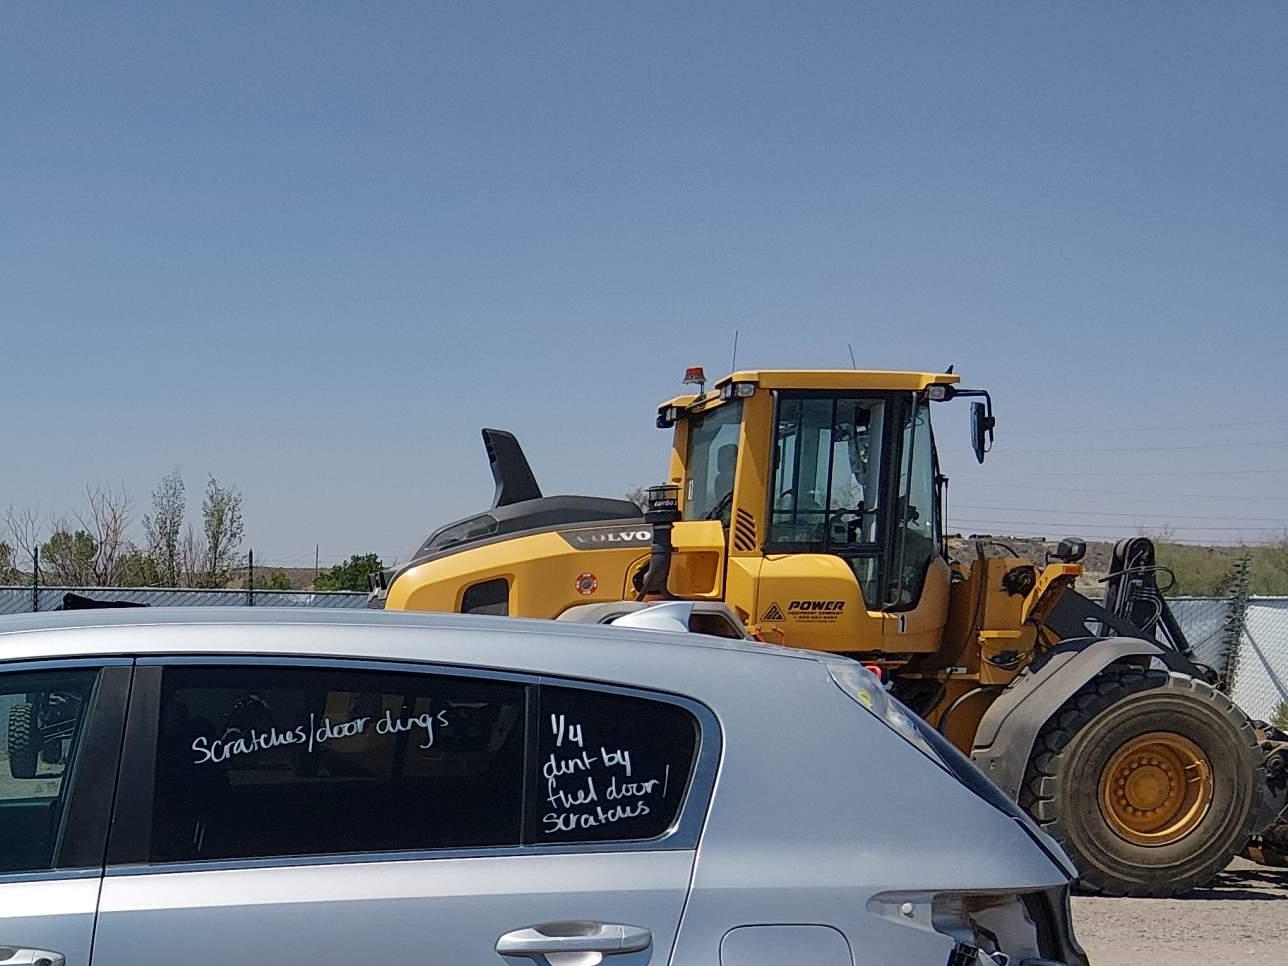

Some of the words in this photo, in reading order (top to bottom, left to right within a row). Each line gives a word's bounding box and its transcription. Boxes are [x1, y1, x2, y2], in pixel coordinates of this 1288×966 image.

[787, 600, 846, 611] POWER
[900, 614, 905, 633] 1
[375, 706, 449, 750] dings
[551, 713, 583, 748] 1/4
[543, 751, 599, 779] dent
[601, 746, 632, 776] by
[547, 776, 598, 808] fuel
